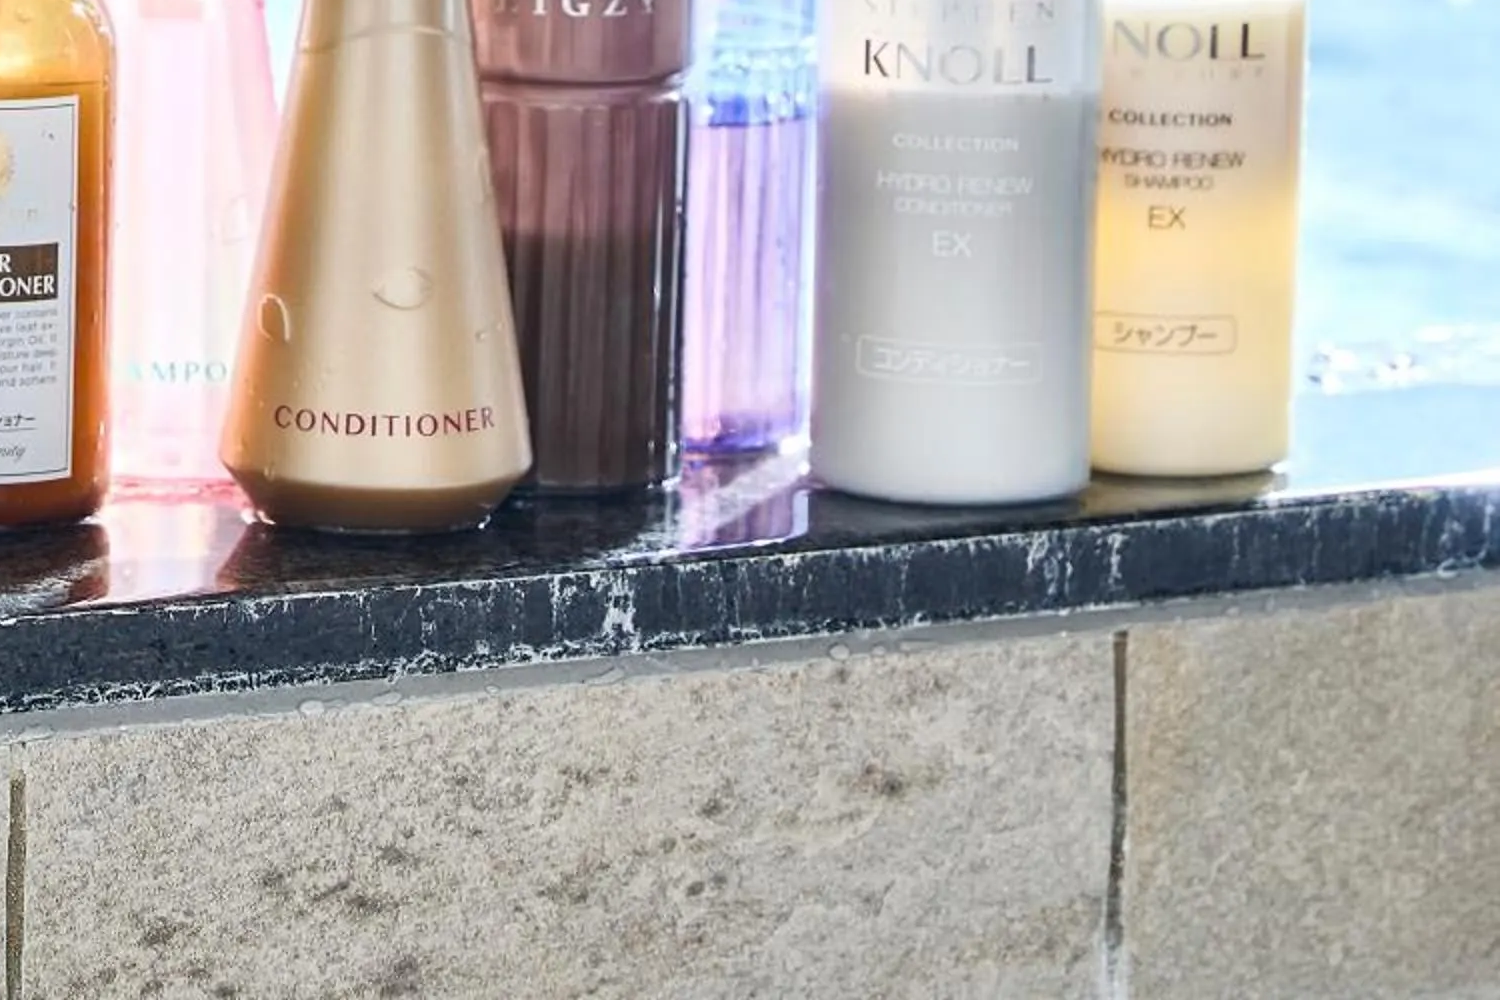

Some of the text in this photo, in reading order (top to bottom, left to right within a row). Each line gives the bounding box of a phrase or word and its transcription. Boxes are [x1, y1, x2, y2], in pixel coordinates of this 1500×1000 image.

[1111, 19, 1266, 62] NOLL
[864, 38, 1053, 85] KNOLL
[1108, 108, 1234, 127] COLLECTION
[1148, 206, 1186, 230] EX
[933, 231, 973, 258] EX
[1113, 320, 1218, 347] シャンプー
[274, 404, 495, 437] CONDITIONER
